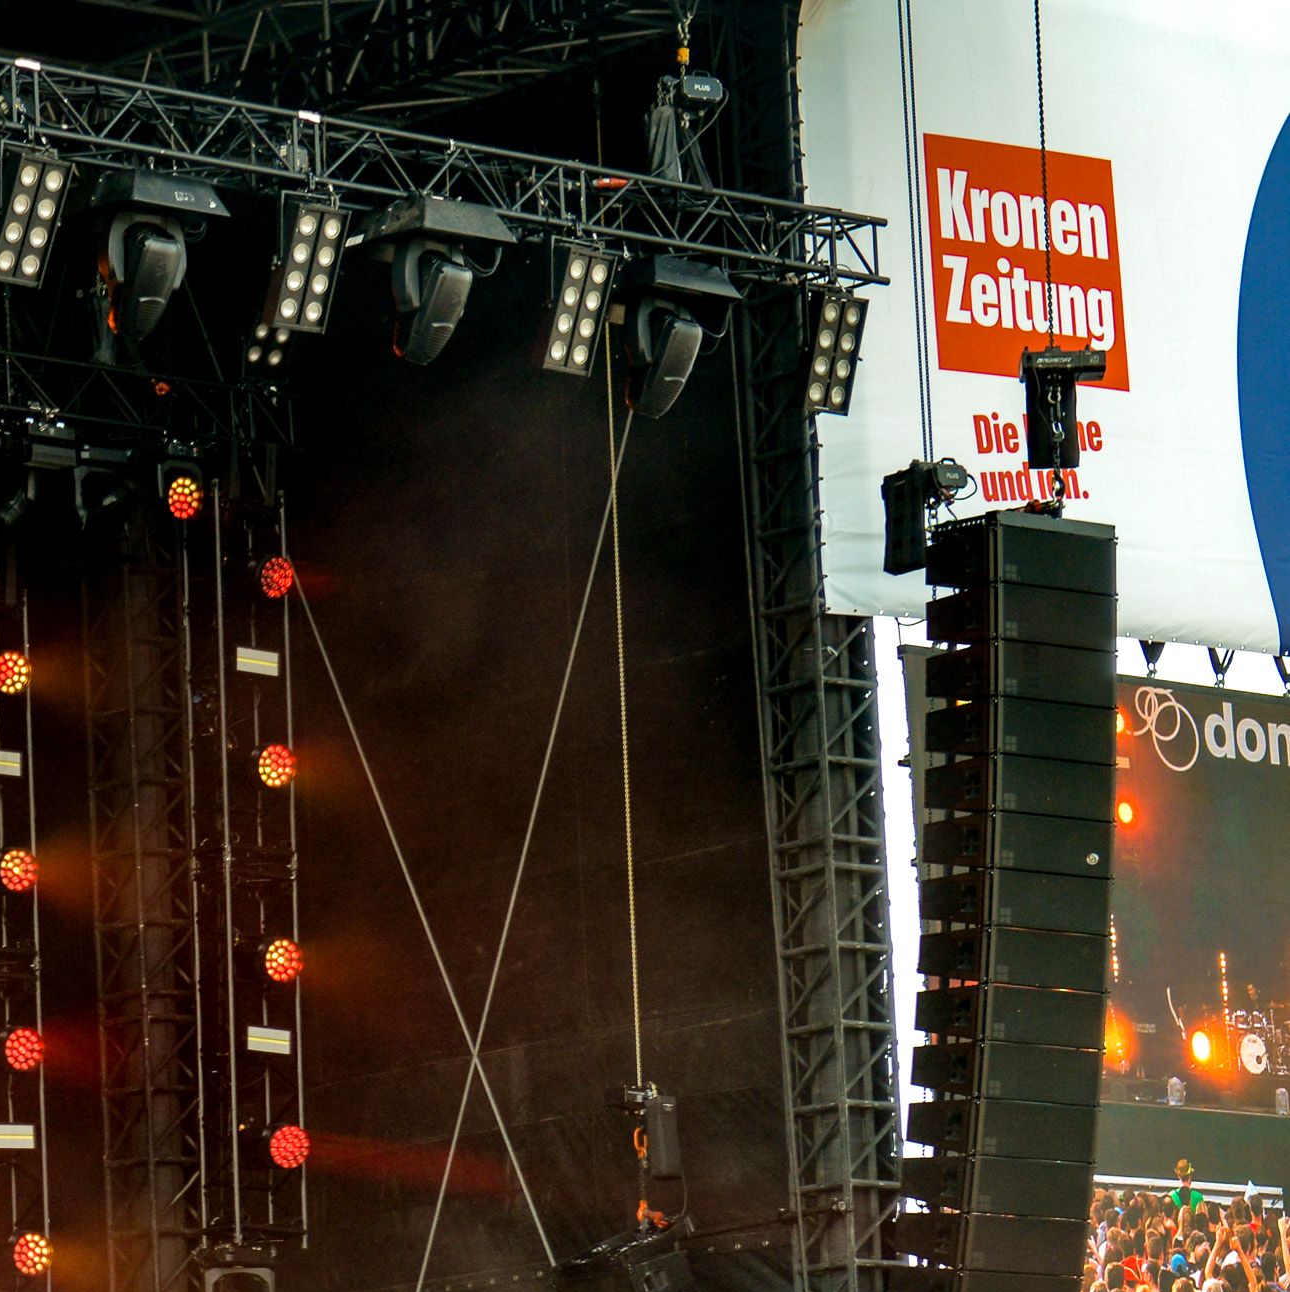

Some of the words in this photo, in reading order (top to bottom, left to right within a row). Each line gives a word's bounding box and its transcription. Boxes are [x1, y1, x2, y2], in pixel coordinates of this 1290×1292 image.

[694, 84, 711, 92] PLUS
[936, 167, 1110, 260] Kronen
[941, 253, 1116, 352] Zeitung
[973, 411, 1020, 454] Die
[980, 461, 1034, 502] und
[1204, 701, 1290, 768] don
